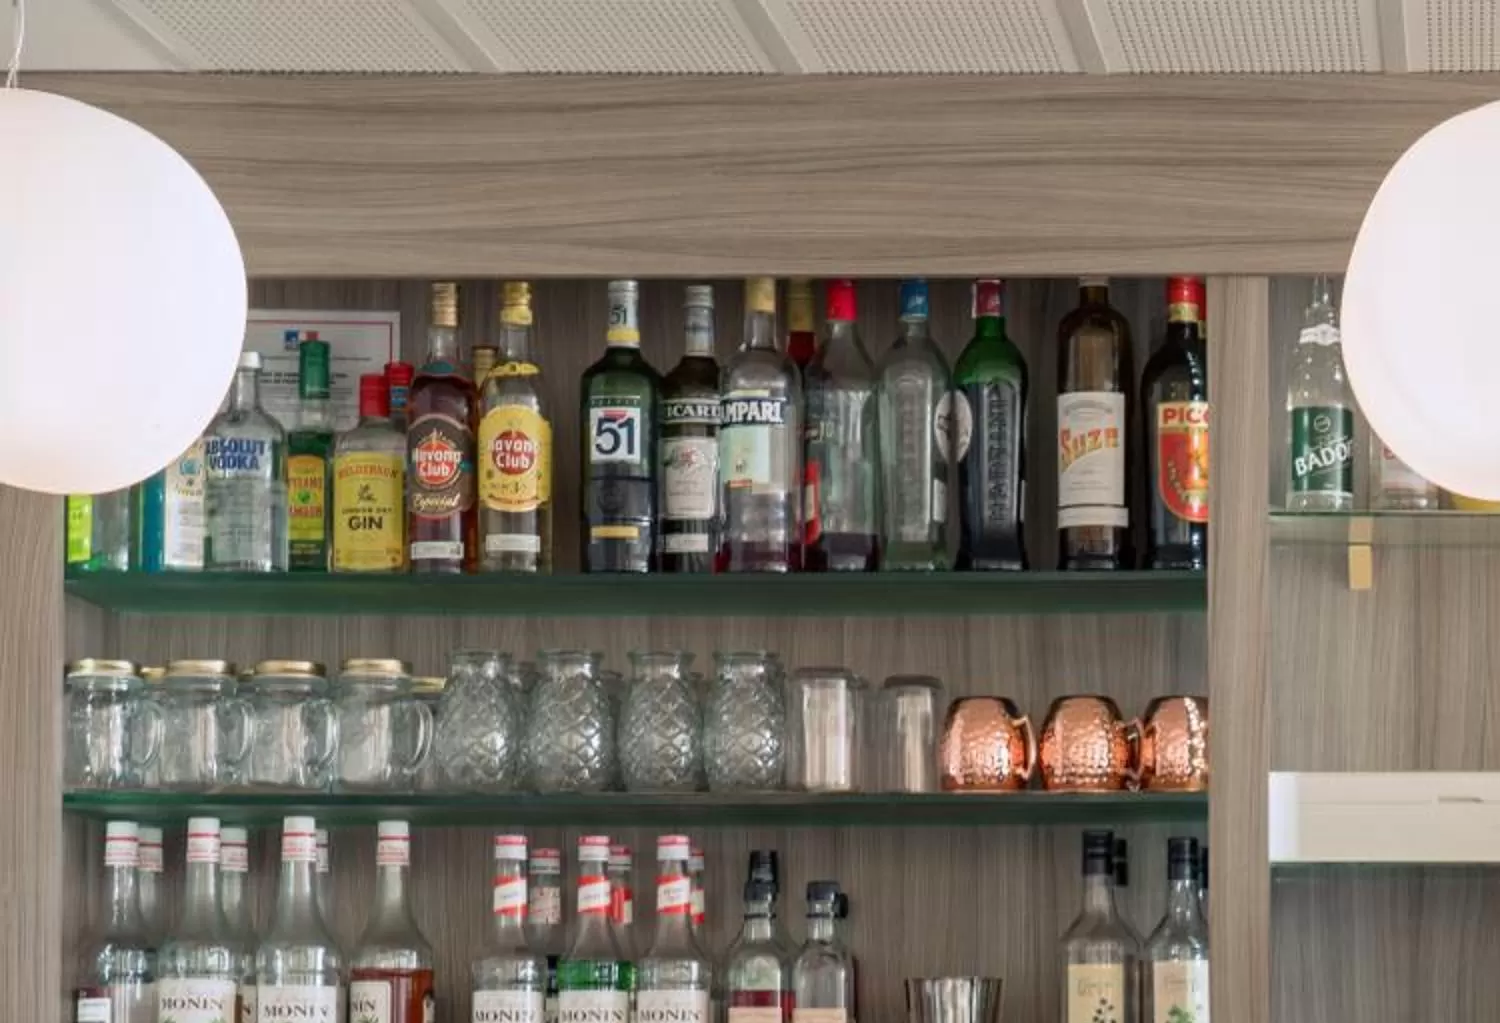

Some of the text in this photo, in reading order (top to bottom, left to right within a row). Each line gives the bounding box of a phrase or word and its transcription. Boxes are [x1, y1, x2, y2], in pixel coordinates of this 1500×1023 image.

[611, 306, 628, 325] 51
[595, 417, 635, 455] 51
[208, 455, 259, 472] VODKA
[419, 460, 450, 476] Club
[496, 451, 530, 469] Club
[348, 515, 384, 531] GIN
[161, 997, 223, 1010] MONIN
[264, 1005, 328, 1017] MONIN
[475, 1010, 535, 1022] MONIN
[561, 1009, 625, 1021] MONIN
[640, 1009, 702, 1021] MONIN
